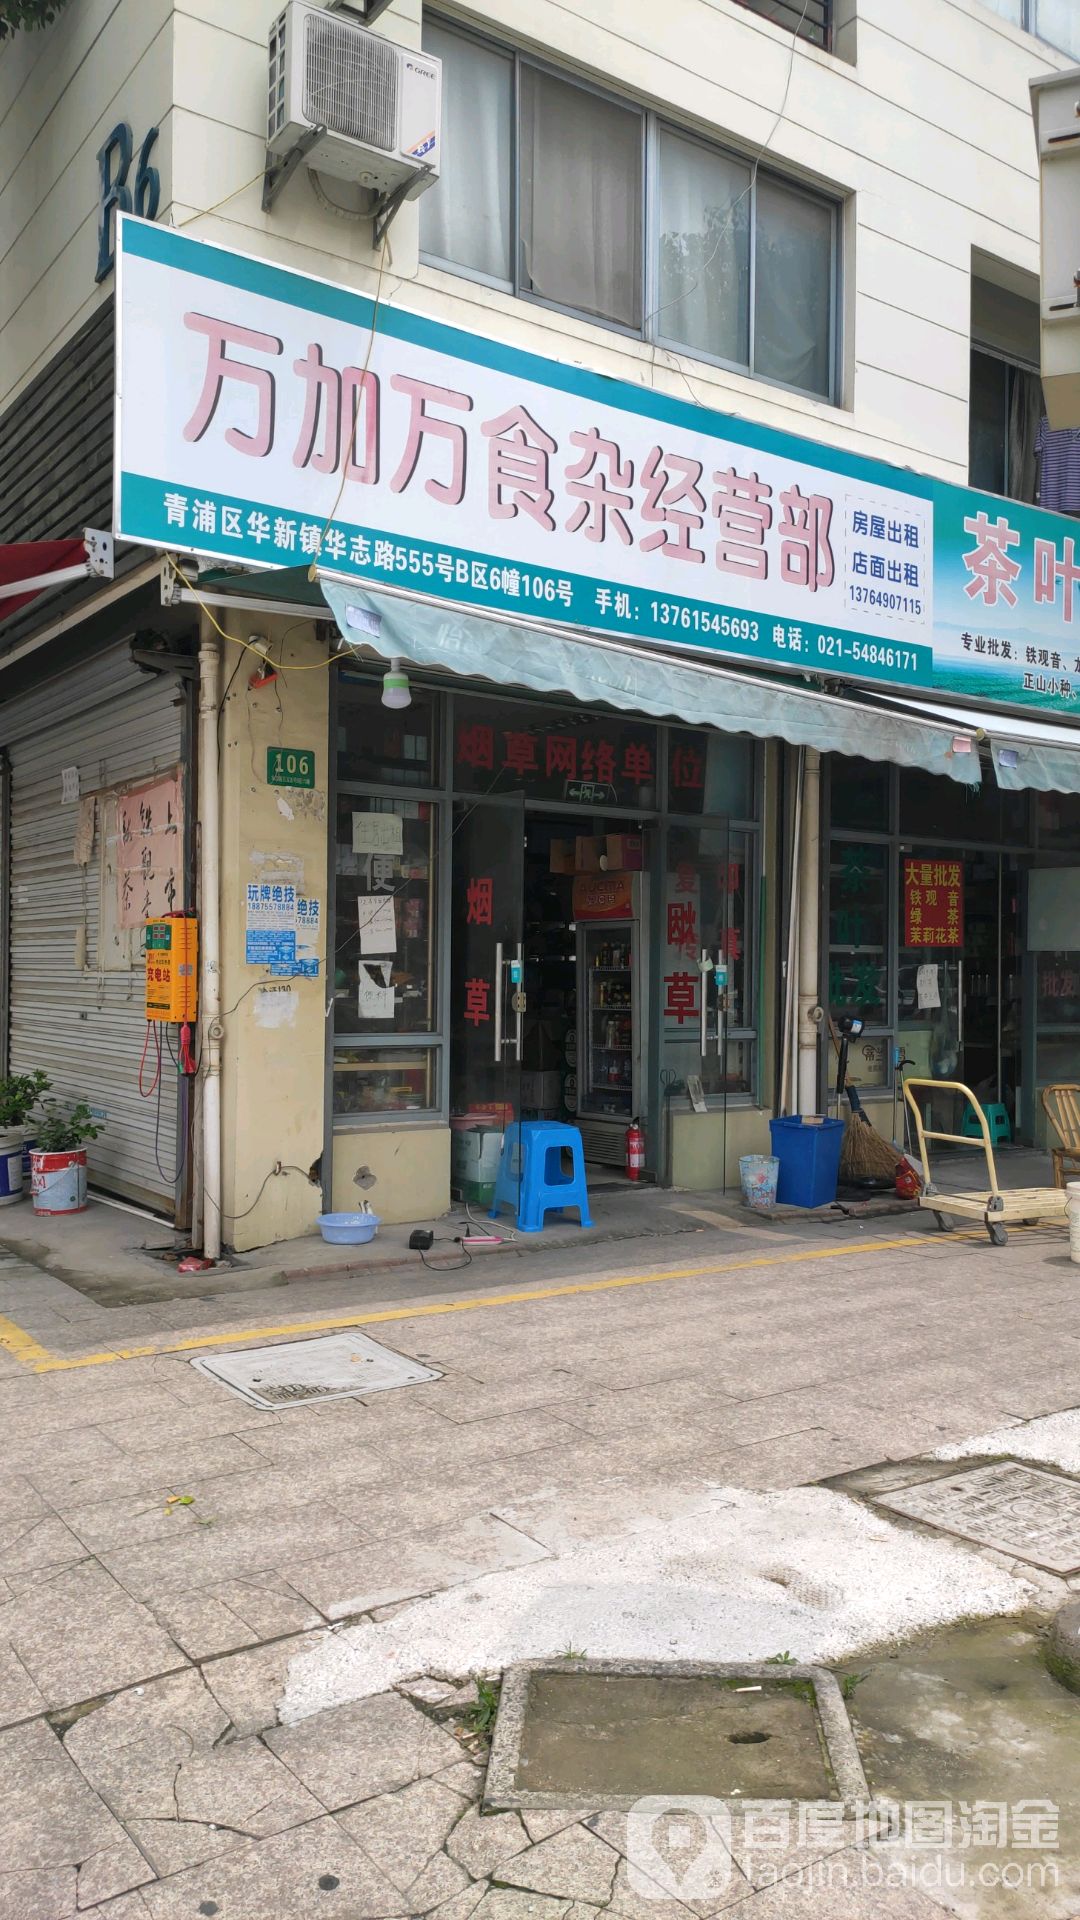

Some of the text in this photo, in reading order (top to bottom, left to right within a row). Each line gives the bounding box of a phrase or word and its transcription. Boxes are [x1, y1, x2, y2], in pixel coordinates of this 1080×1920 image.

[414, 67, 436, 80] GREE
[95, 122, 160, 283] B6
[183, 311, 834, 593] 万加万食杂经营部
[853, 510, 919, 549] 房屋出租
[163, 492, 574, 608] 青浦区华新镇华志路555号B区6幢106号
[853, 551, 919, 588] 店面出租
[962, 510, 1080, 624] 茶叶
[849, 585, 922, 616] 13764907115
[273, 753, 309, 775] 106
[456, 723, 705, 789] 烟草网络单位
[364, 854, 396, 892] 便
[905, 863, 961, 887] 大量批发
[247, 885, 295, 902] 玩牌绝技
[296, 899, 320, 917] 绝技
[910, 889, 960, 907] 铁观音
[910, 907, 960, 925] 绿茶
[910, 927, 960, 944] 茉莉花茶
[463, 877, 495, 1027] 烟草
[147, 966, 171, 983] 充电站
